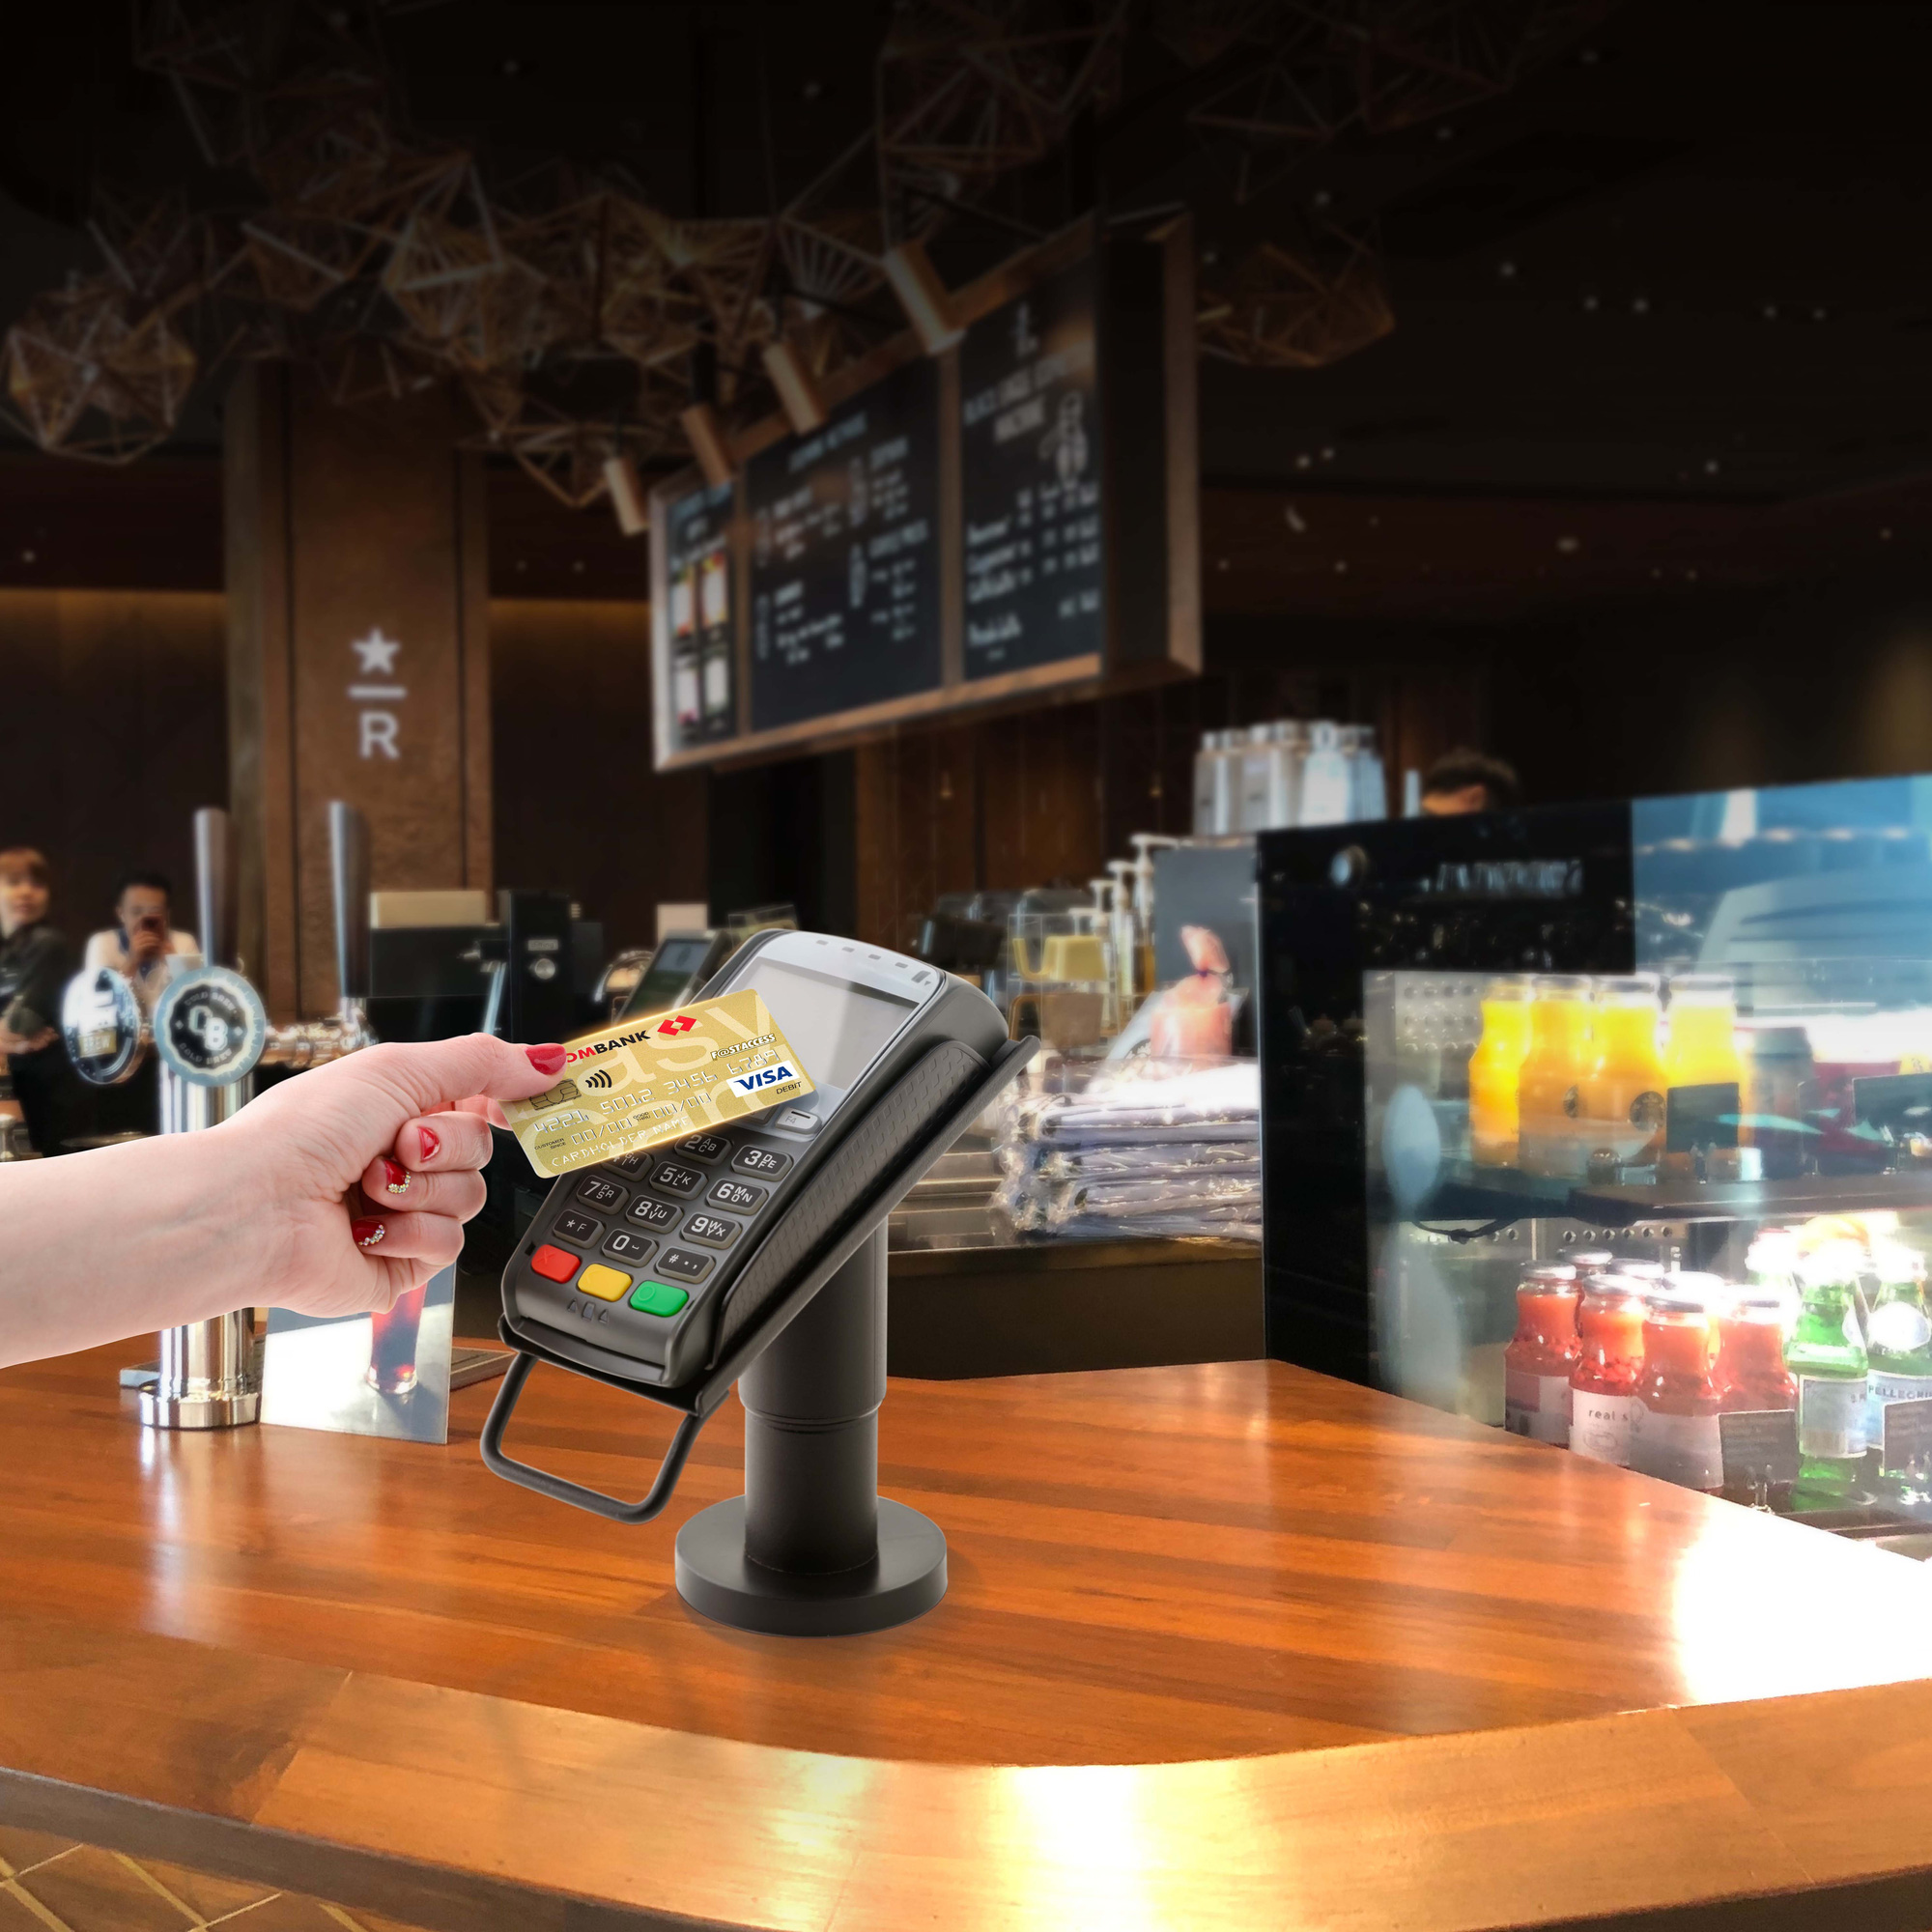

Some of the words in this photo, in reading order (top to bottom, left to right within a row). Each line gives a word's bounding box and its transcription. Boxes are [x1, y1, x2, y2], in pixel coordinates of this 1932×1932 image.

[359, 711, 400, 759] R
[566, 1030, 651, 1063] OMBANK
[733, 1065, 793, 1091] VISA
[534, 1110, 589, 1134] 4221
[600, 1089, 656, 1115] 5012
[663, 1071, 718, 1095] 3456
[726, 1049, 781, 1075] 6789
[776, 1081, 802, 1094] DEBIT
[534, 1138, 565, 1151] CUSTOMER
[550, 1142, 567, 1151] SINCE
[552, 1130, 648, 1167] CARDHOLDER
[652, 1116, 691, 1135] NAME
[684, 1134, 702, 1151] 2
[744, 1150, 762, 1165] 3
[659, 1167, 677, 1182] 5
[583, 1180, 601, 1196] 7
[717, 1182, 734, 1199] 6
[635, 1201, 652, 1216] 8
[691, 1217, 709, 1233] 9
[612, 1235, 630, 1251] 0
[1588, 1409, 1616, 1421] real
